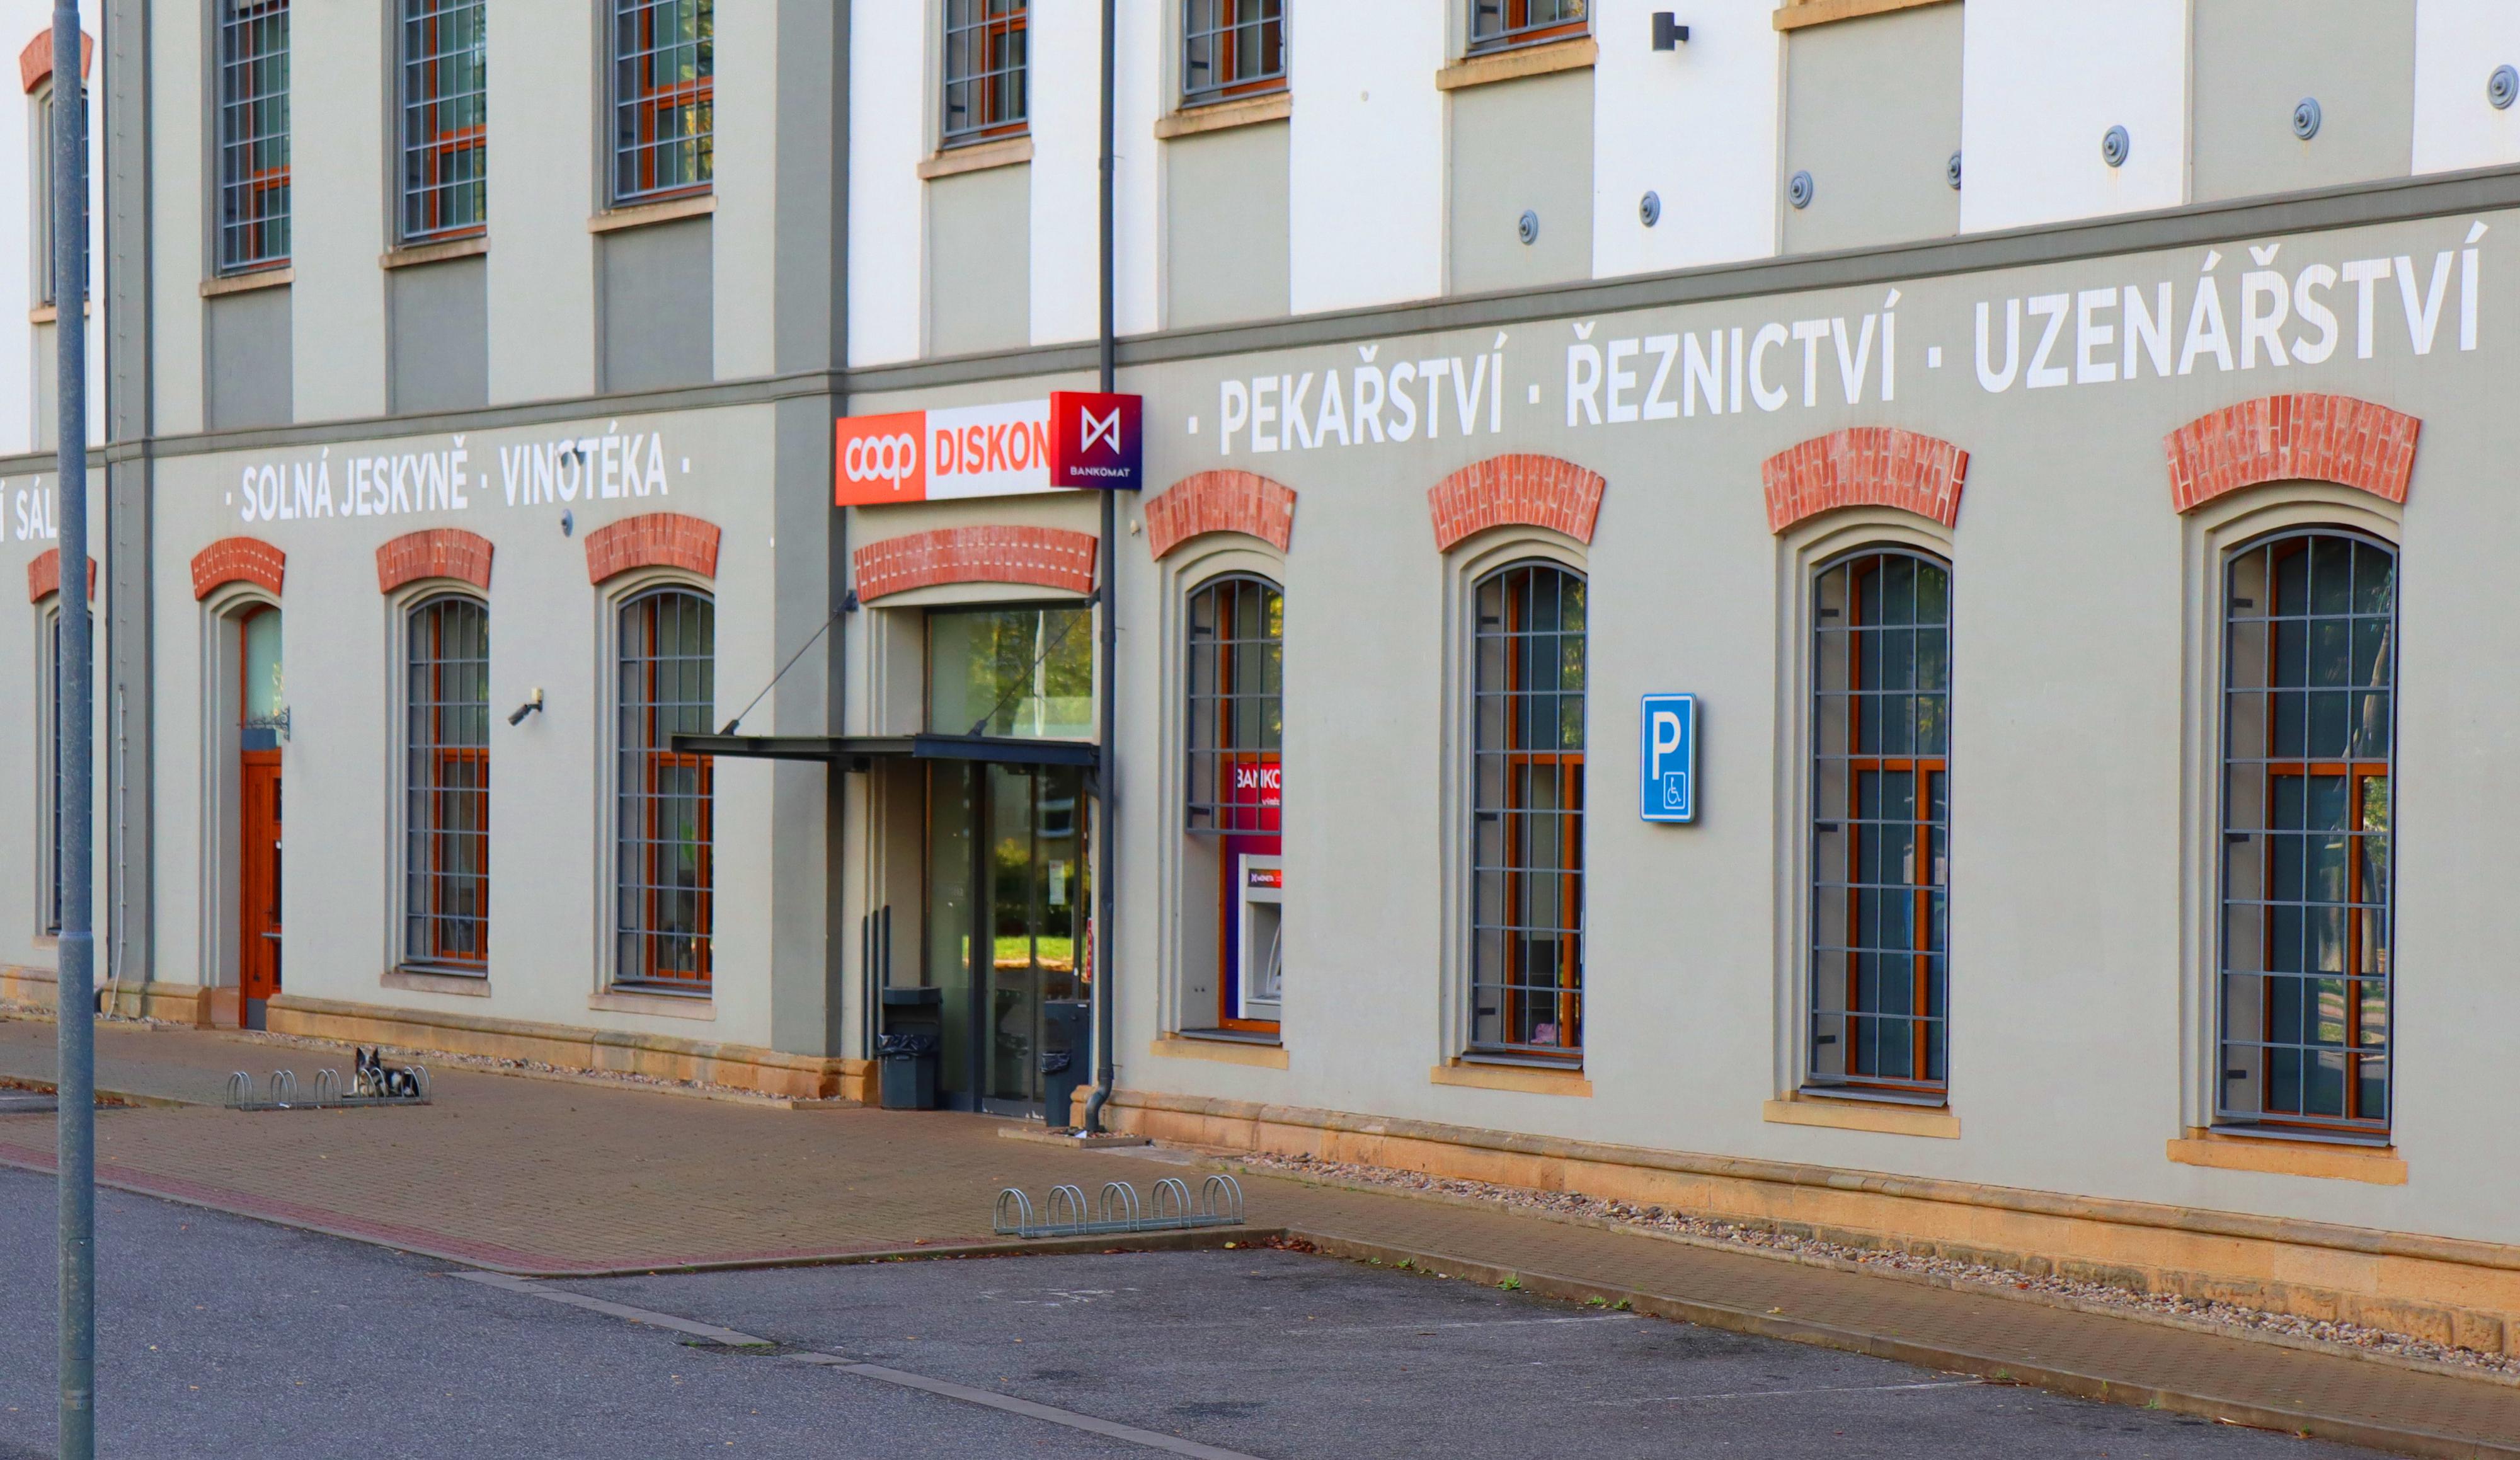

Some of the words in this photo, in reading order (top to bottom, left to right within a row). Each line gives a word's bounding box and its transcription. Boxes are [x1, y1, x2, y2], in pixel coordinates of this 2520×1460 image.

[1220, 331, 1509, 455] PEKAŘSTVÍ
[1566, 288, 1902, 427] ŘEZNICTVÍ
[1975, 220, 2488, 393] UZENÁŘSTVÍ
[241, 446, 334, 522] SOLNÁ
[340, 435, 469, 517] JESKYNĚ
[500, 419, 669, 507] VINOTÉKA
[845, 432, 917, 490] coop
[936, 420, 1051, 476] DISKON
[1070, 466, 1131, 478] BANKOMAT
[16, 474, 58, 541] SÁL
[1237, 768, 1280, 789] BANKO
[1652, 711, 1681, 780] P
